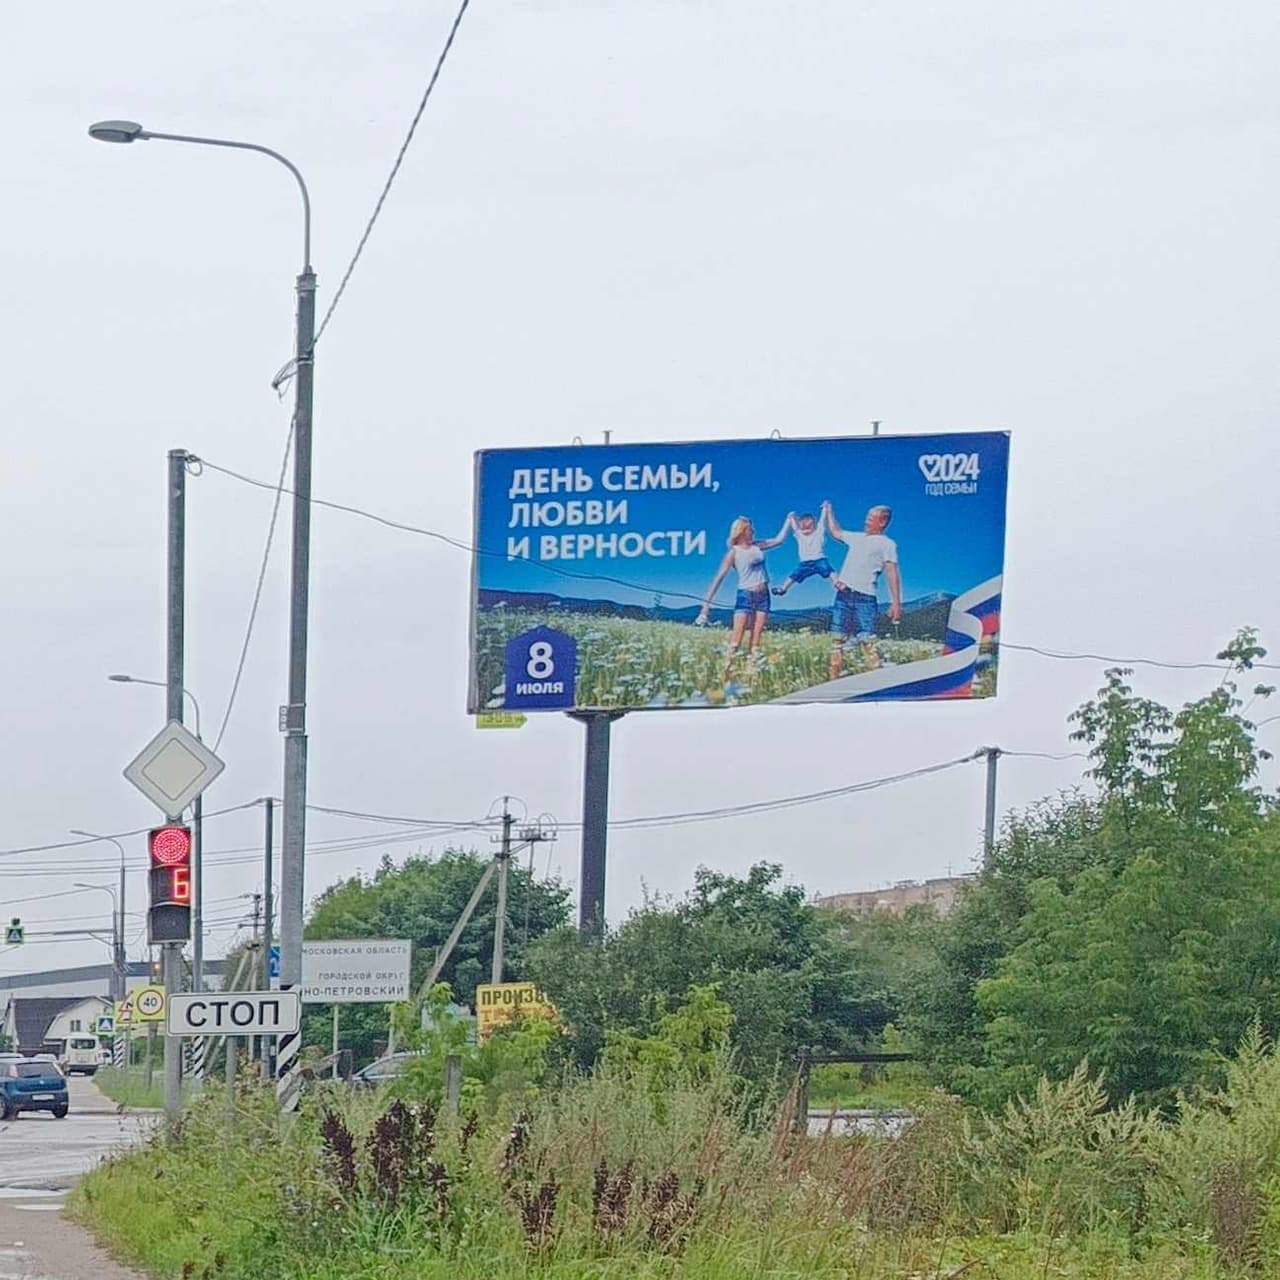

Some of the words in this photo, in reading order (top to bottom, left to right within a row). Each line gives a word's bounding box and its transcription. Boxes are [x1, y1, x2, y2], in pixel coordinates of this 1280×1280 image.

[509, 467, 593, 499] ДЕНЬ
[602, 463, 720, 492] СЕМЬИ,
[920, 453, 980, 481] 2024
[508, 499, 628, 528] ЛЮБВИ
[507, 536, 530, 561] И
[540, 530, 706, 560] ВЕРНОСТИ
[527, 641, 554, 679] 8
[303, 985, 404, 997] НО-ПЕТРОВСКИЙ
[186, 1000, 279, 1027] СТОП
